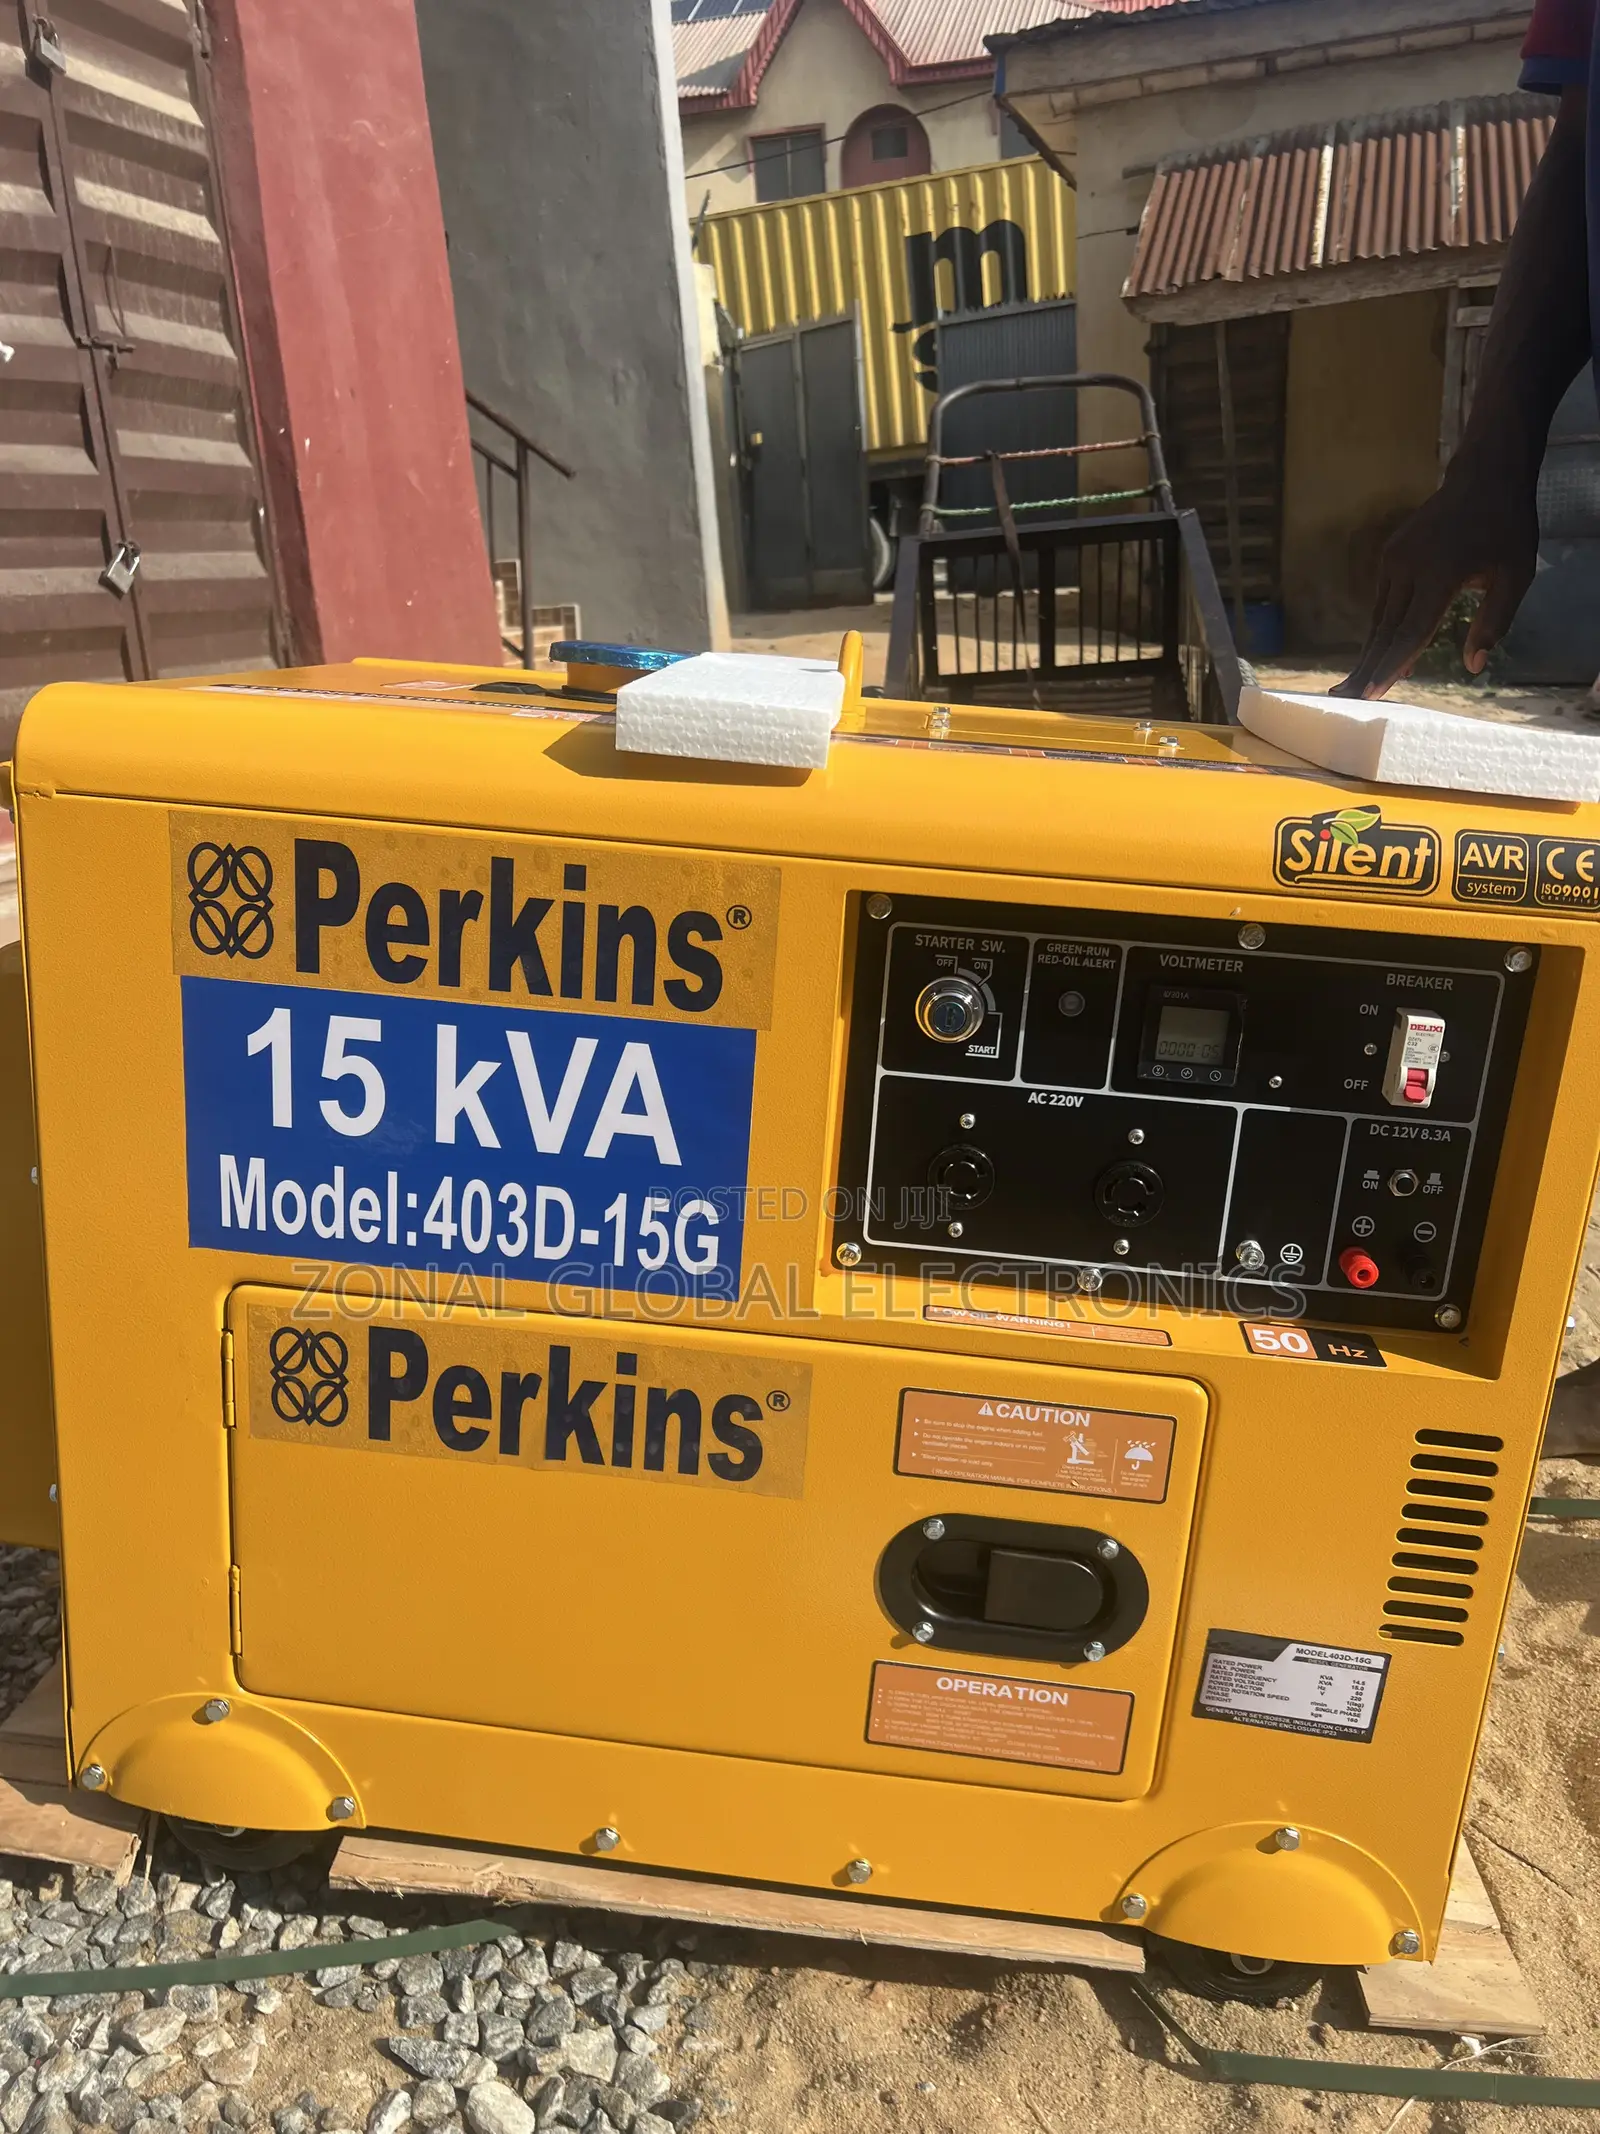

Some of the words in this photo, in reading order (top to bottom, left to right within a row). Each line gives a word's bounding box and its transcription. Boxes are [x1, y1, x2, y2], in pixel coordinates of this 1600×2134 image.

[1284, 827, 1432, 879] Silent
[1462, 841, 1525, 872] AVR
[1466, 880, 1517, 897] system
[1541, 882, 1599, 899] ISO9001
[915, 934, 975, 950] STARTER
[981, 941, 1006, 953] SW.
[1046, 943, 1110, 957] GREEN-RUN
[936, 958, 955, 968] OFF
[974, 961, 988, 970] ON
[1037, 954, 1080, 967] RED-OIL
[1082, 957, 1116, 970] ALERT
[1159, 954, 1244, 973] VOLTMETER
[1386, 973, 1454, 991] BREAKER
[1360, 1004, 1379, 1016] ON
[1410, 1023, 1443, 1033] DELIXI
[968, 1044, 996, 1055] START
[246, 1007, 387, 1137] 15
[435, 1024, 683, 1166] kVA
[1343, 1078, 1369, 1090] OFF
[1028, 1092, 1047, 1104] AC
[1049, 1093, 1084, 1108] 220V
[1369, 1123, 1390, 1136] DC
[1392, 1126, 1419, 1139] 12V
[1420, 1128, 1451, 1142] 8.3A
[1362, 1180, 1378, 1190] ON
[1422, 1185, 1444, 1195] OFF
[219, 1154, 721, 1275] Model:403D-15G
[933, 1307, 966, 1316] LOW
[969, 1312, 992, 1320] OIL
[996, 1315, 1071, 1328] WARNING!
[1252, 1328, 1308, 1353] 50
[1327, 1343, 1368, 1359] Hz
[996, 1403, 1090, 1427] CAUTION
[1296, 1648, 1372, 1665] MODEL403D-15G
[1237, 1662, 1262, 1670] POWER
[1234, 1678, 1265, 1686] VOLTAGE
[1235, 1674, 1277, 1682] FREQUENCY
[936, 1677, 1068, 1706] OPERATION
[1232, 1688, 1265, 1698] ROTATION
[1206, 1706, 1248, 1717] GENERATOR
[1293, 1720, 1333, 1730] INSULATION
[1315, 1707, 1338, 1715] SINGLE
[1339, 1710, 1361, 1718] PHASE
[1233, 1716, 1278, 1726] ALTERNATOR
[1279, 1723, 1321, 1733] ENCLOSURE
